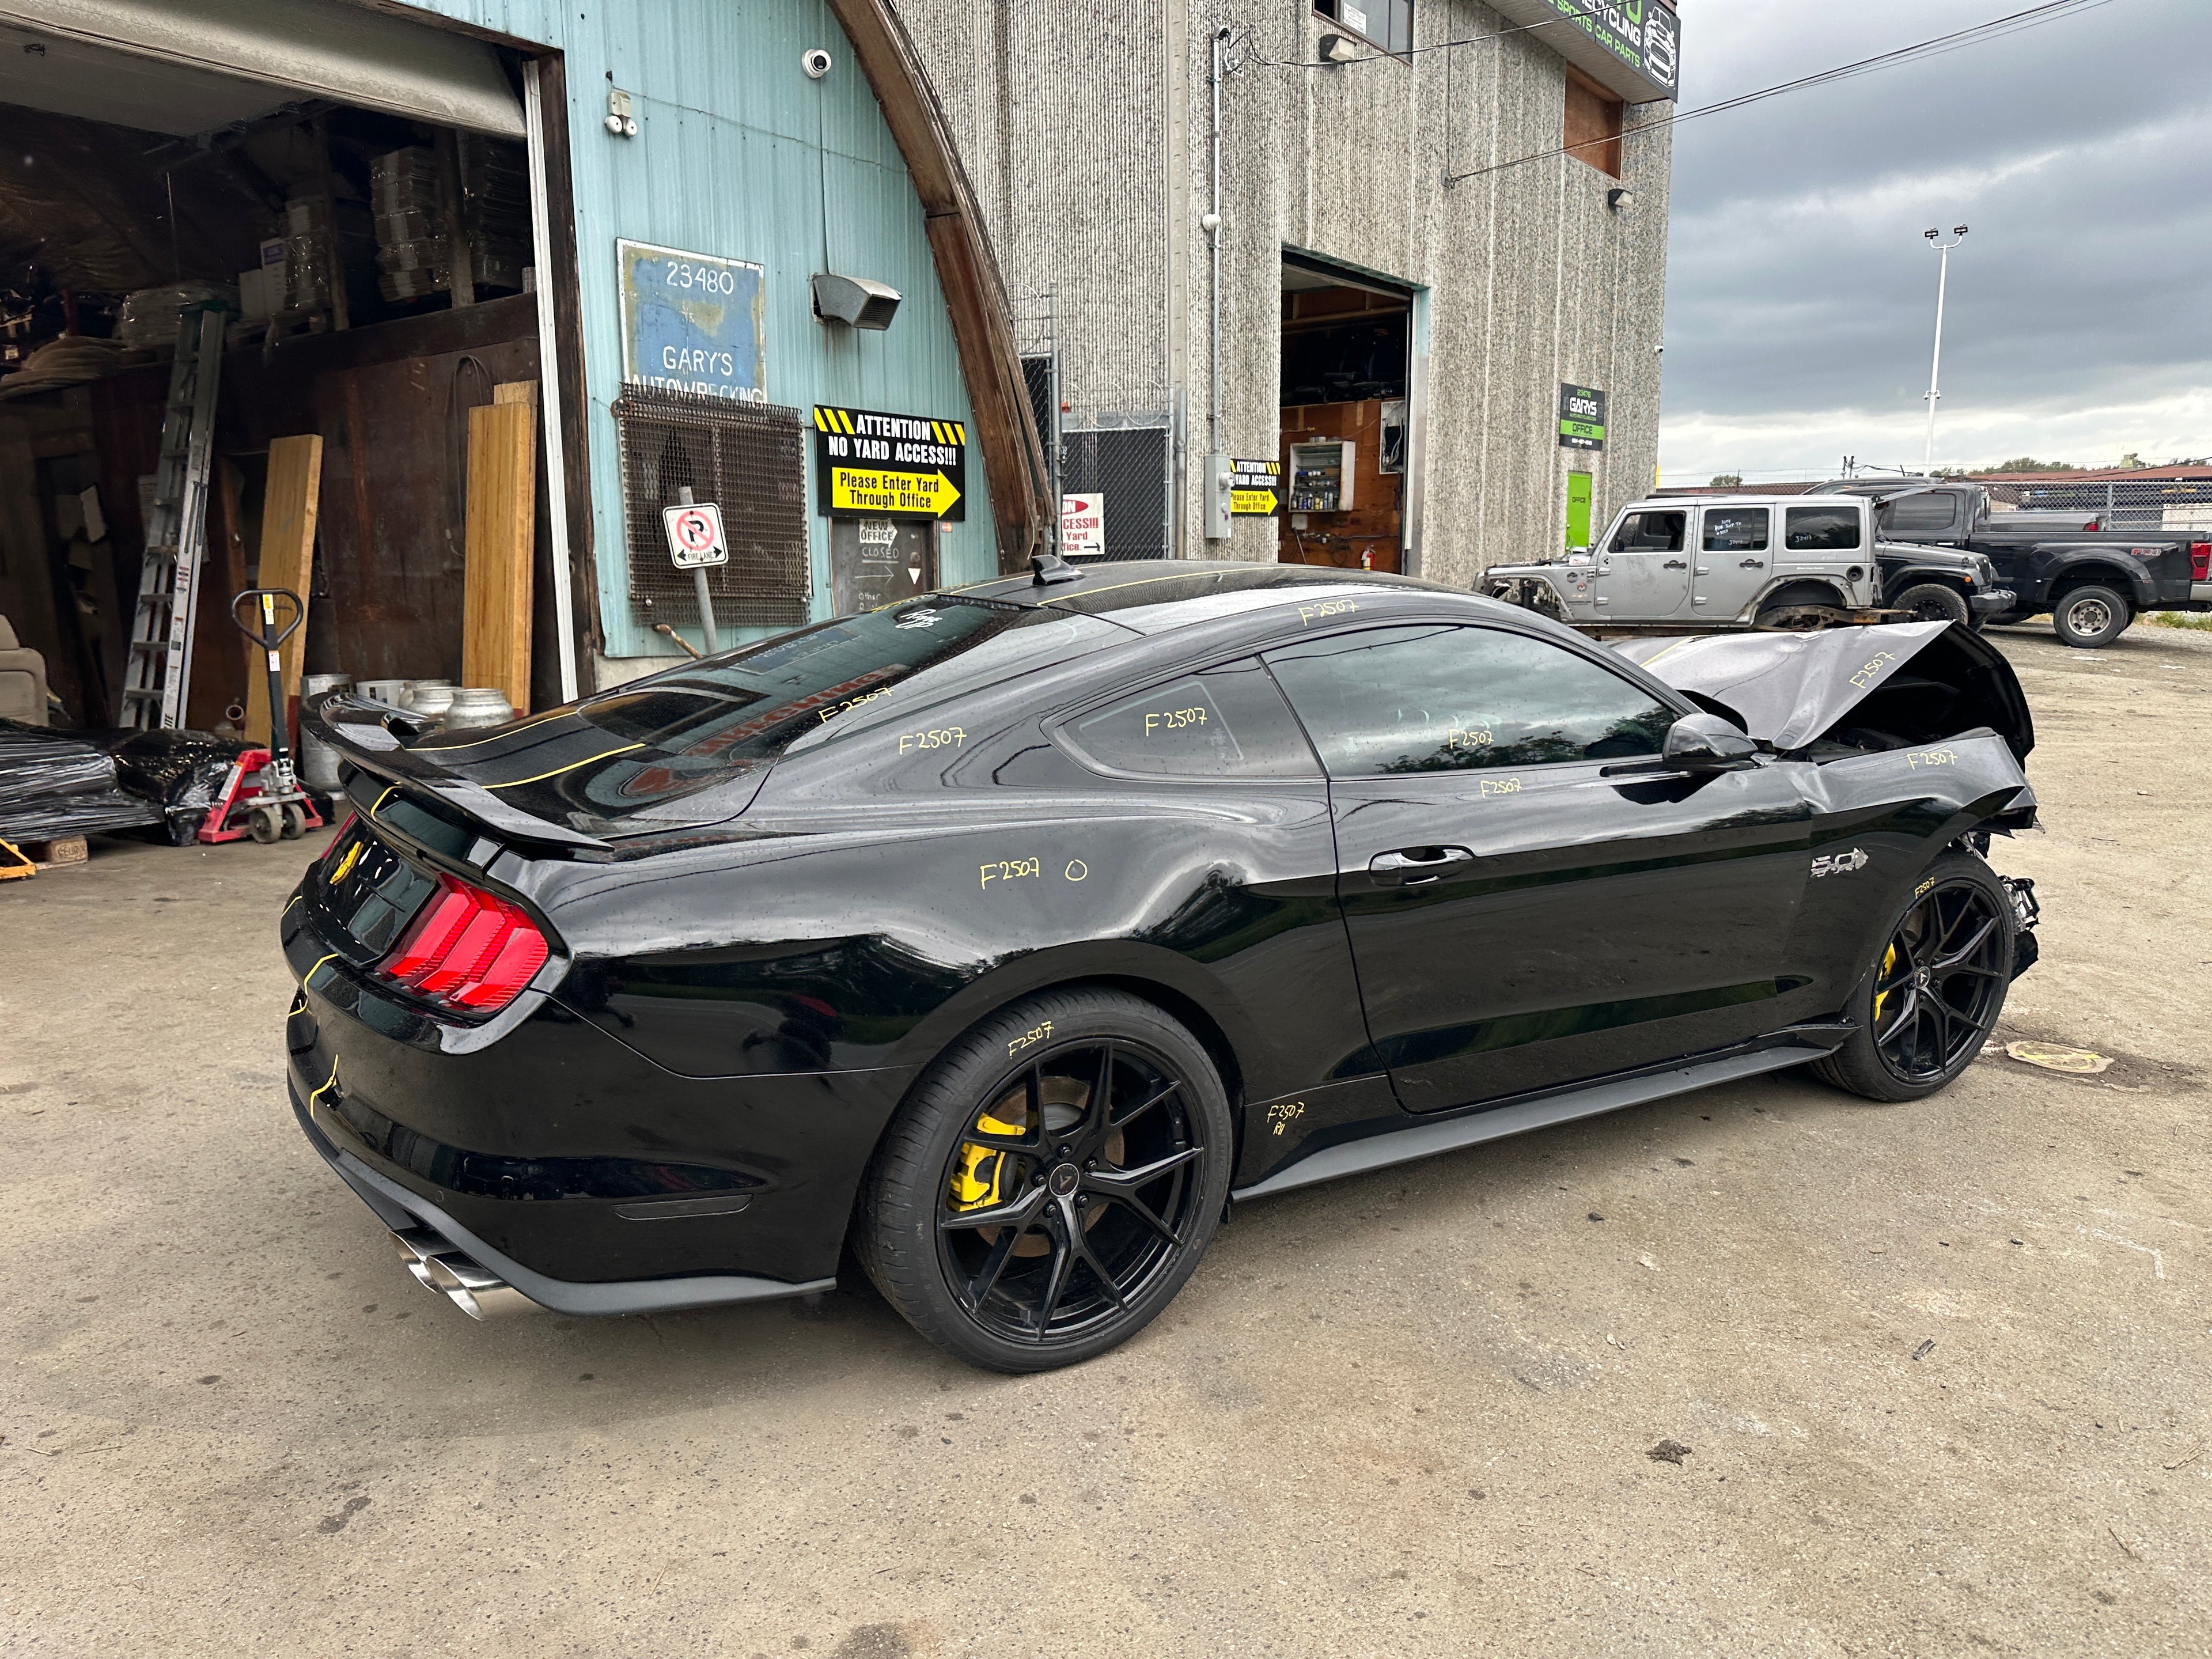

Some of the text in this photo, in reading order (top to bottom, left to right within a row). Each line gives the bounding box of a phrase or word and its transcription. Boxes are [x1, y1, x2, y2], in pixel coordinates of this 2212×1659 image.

[1582, 0, 1641, 47] ECYCLING
[1596, 24, 1612, 48] CAR
[1615, 39, 1641, 68] PARTS
[667, 261, 733, 294] 23480
[663, 346, 733, 376] GARY'S
[1570, 397, 1597, 416] GARYS
[856, 414, 930, 441] ATTENTION
[1572, 423, 1593, 435] OFFICE
[828, 435, 956, 466] NO YARD ACCESS!!!
[1236, 461, 1266, 473] ATTENTION
[840, 472, 939, 493] Please Enter Yard
[1235, 475, 1249, 485] YARD
[850, 490, 931, 509] Through Office
[1246, 493, 1258, 501] Enter
[1259, 493, 1269, 501] Yard
[865, 520, 888, 531] NEW
[1063, 518, 1099, 529] CESS!!!
[861, 530, 893, 541] OFFICE
[1066, 531, 1088, 540] Yard
[688, 552, 699, 560] FIRE
[862, 547, 899, 559] CLOSED
[1298, 599, 1359, 626] F2507
[1849, 652, 1895, 688] F2507
[818, 687, 895, 722] F2507
[1145, 707, 1207, 737] F2507
[899, 727, 967, 755] F2507
[1448, 729, 1494, 748] F2507
[1907, 750, 1958, 770] F2507
[1480, 778, 1522, 797] F2507
[980, 857, 1040, 890] F2507
[1914, 877, 1935, 899] F2507
[1008, 1021, 1054, 1059] F2507
[1267, 1101, 1304, 1123] F2507
